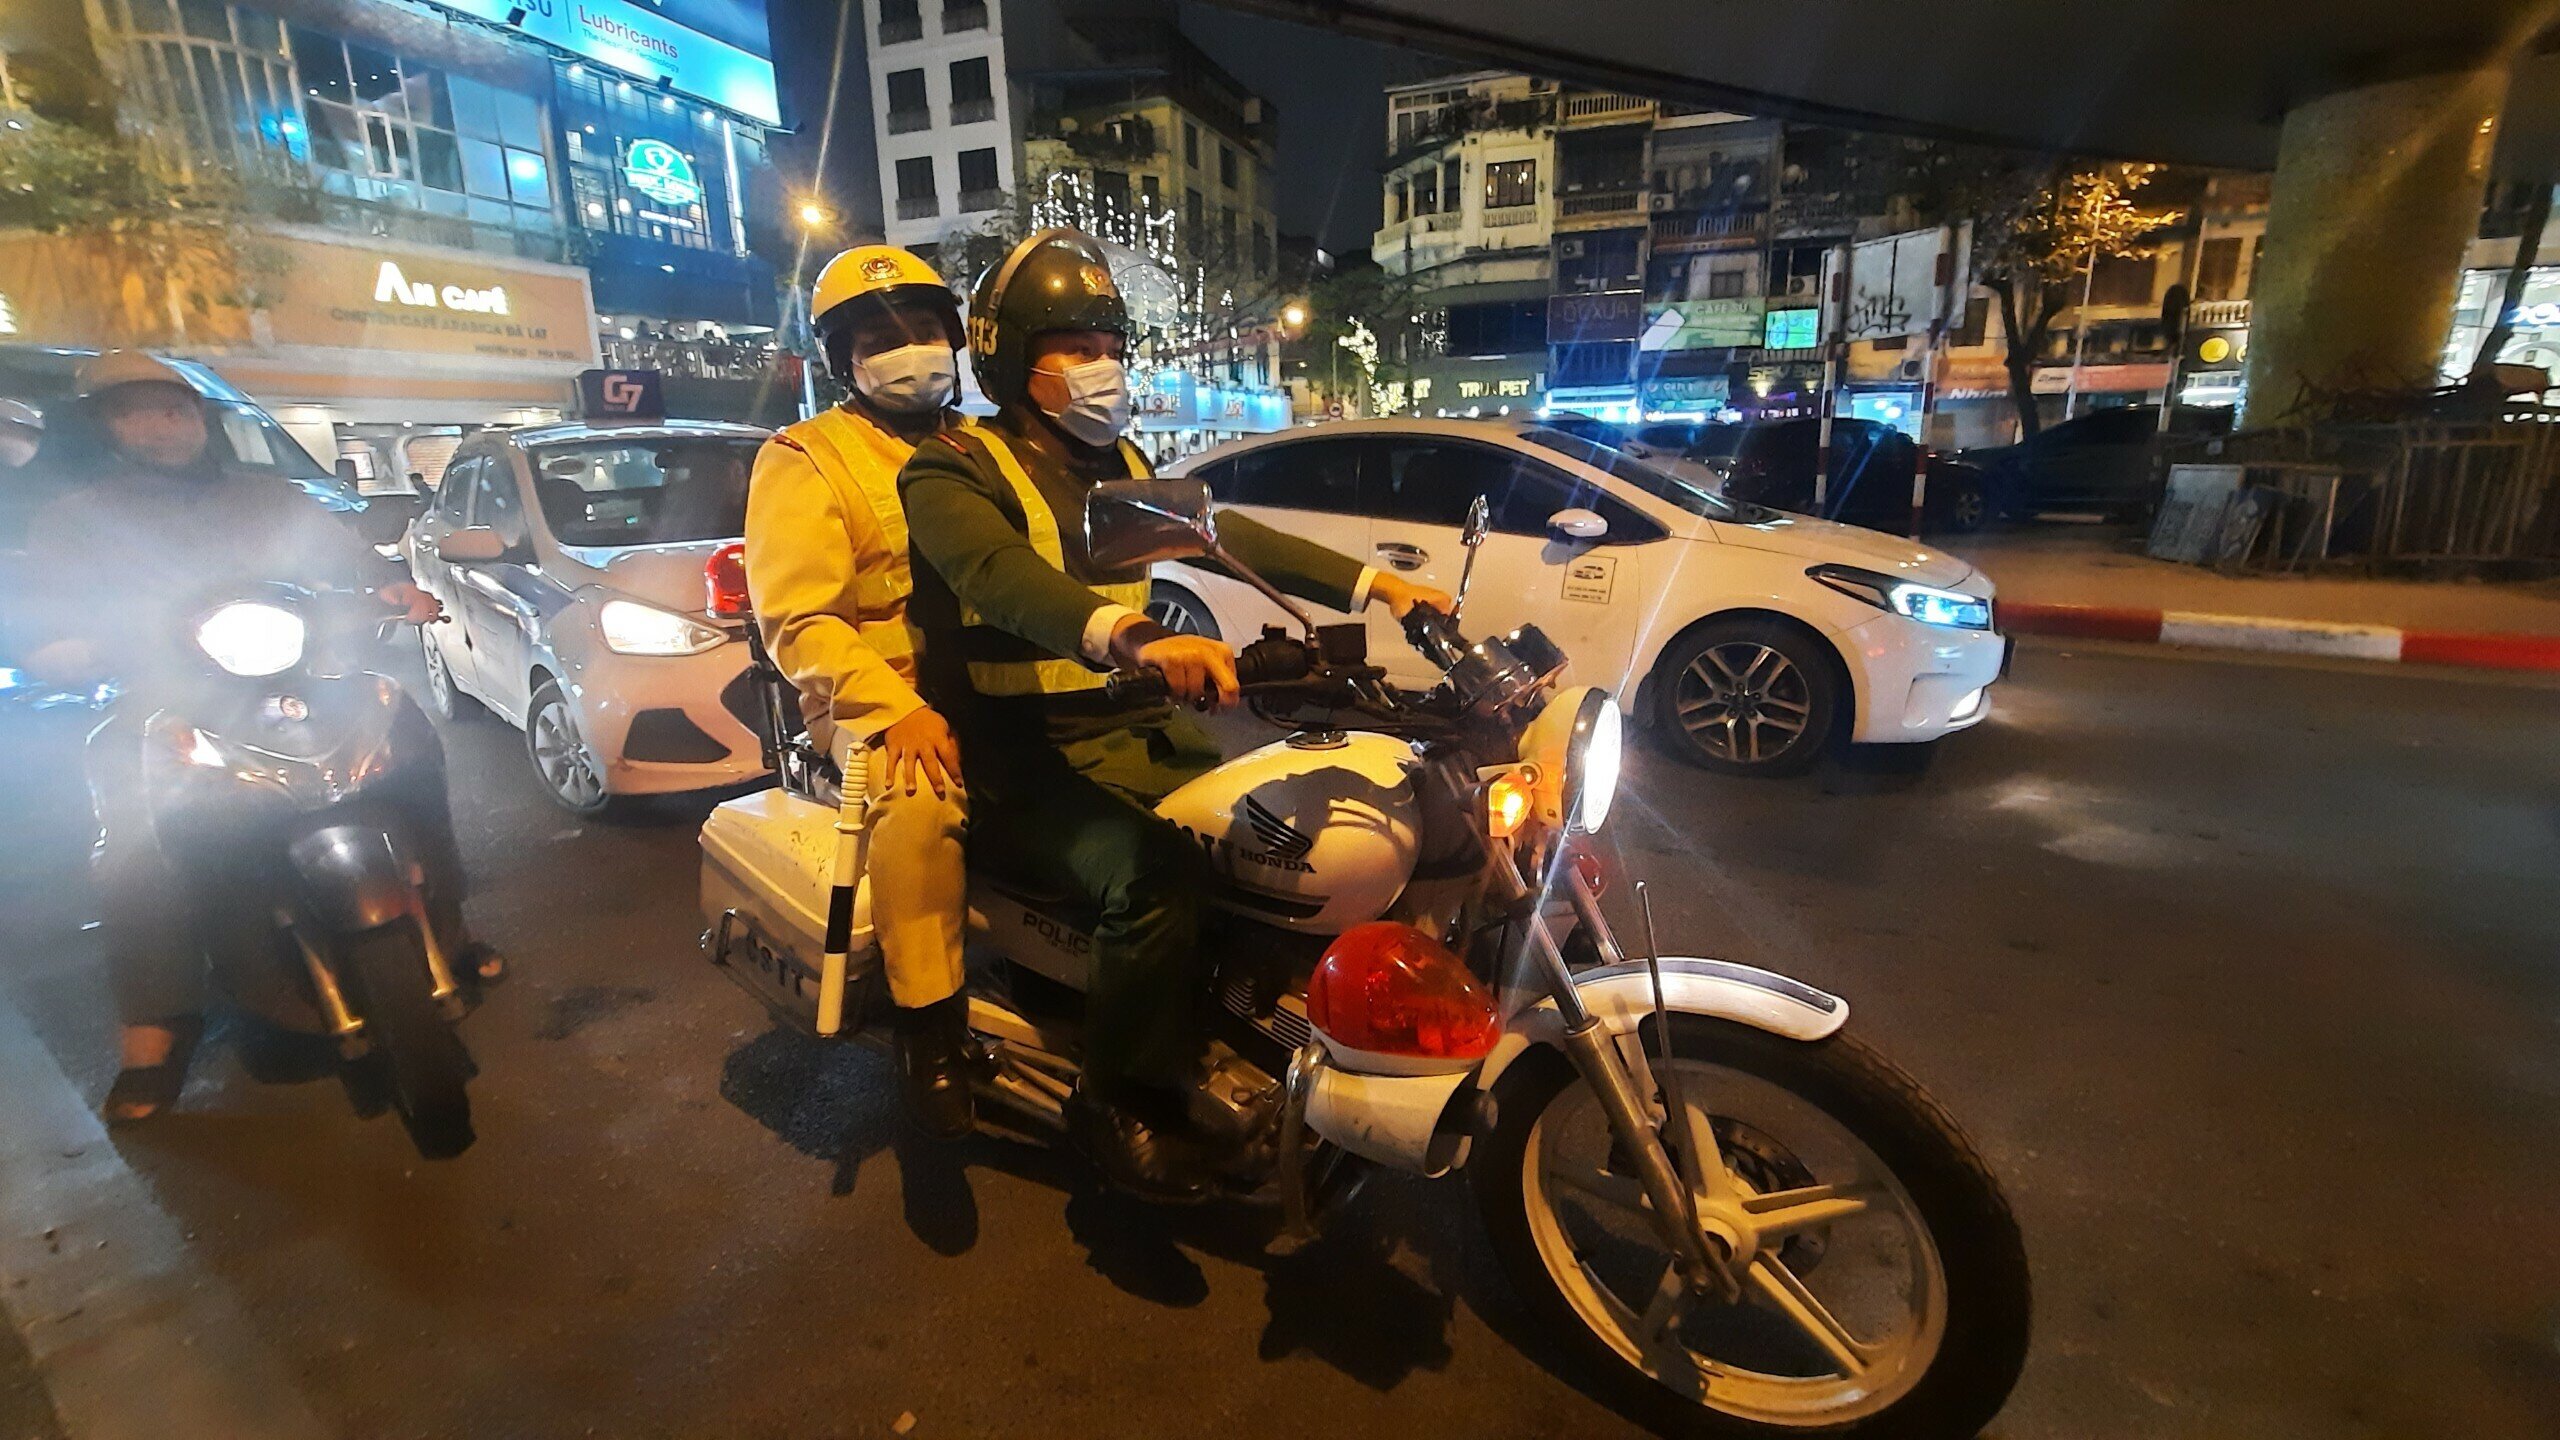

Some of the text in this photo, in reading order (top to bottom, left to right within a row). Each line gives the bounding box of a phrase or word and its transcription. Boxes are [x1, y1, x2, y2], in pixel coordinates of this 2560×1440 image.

[578, 5, 679, 59] Lubricants
[582, 28, 600, 41] The
[604, 374, 643, 412] G7
[1458, 379, 1530, 399] TRUPET
[1240, 848, 1318, 875] HONDA
[1023, 911, 1090, 954] POLIC
